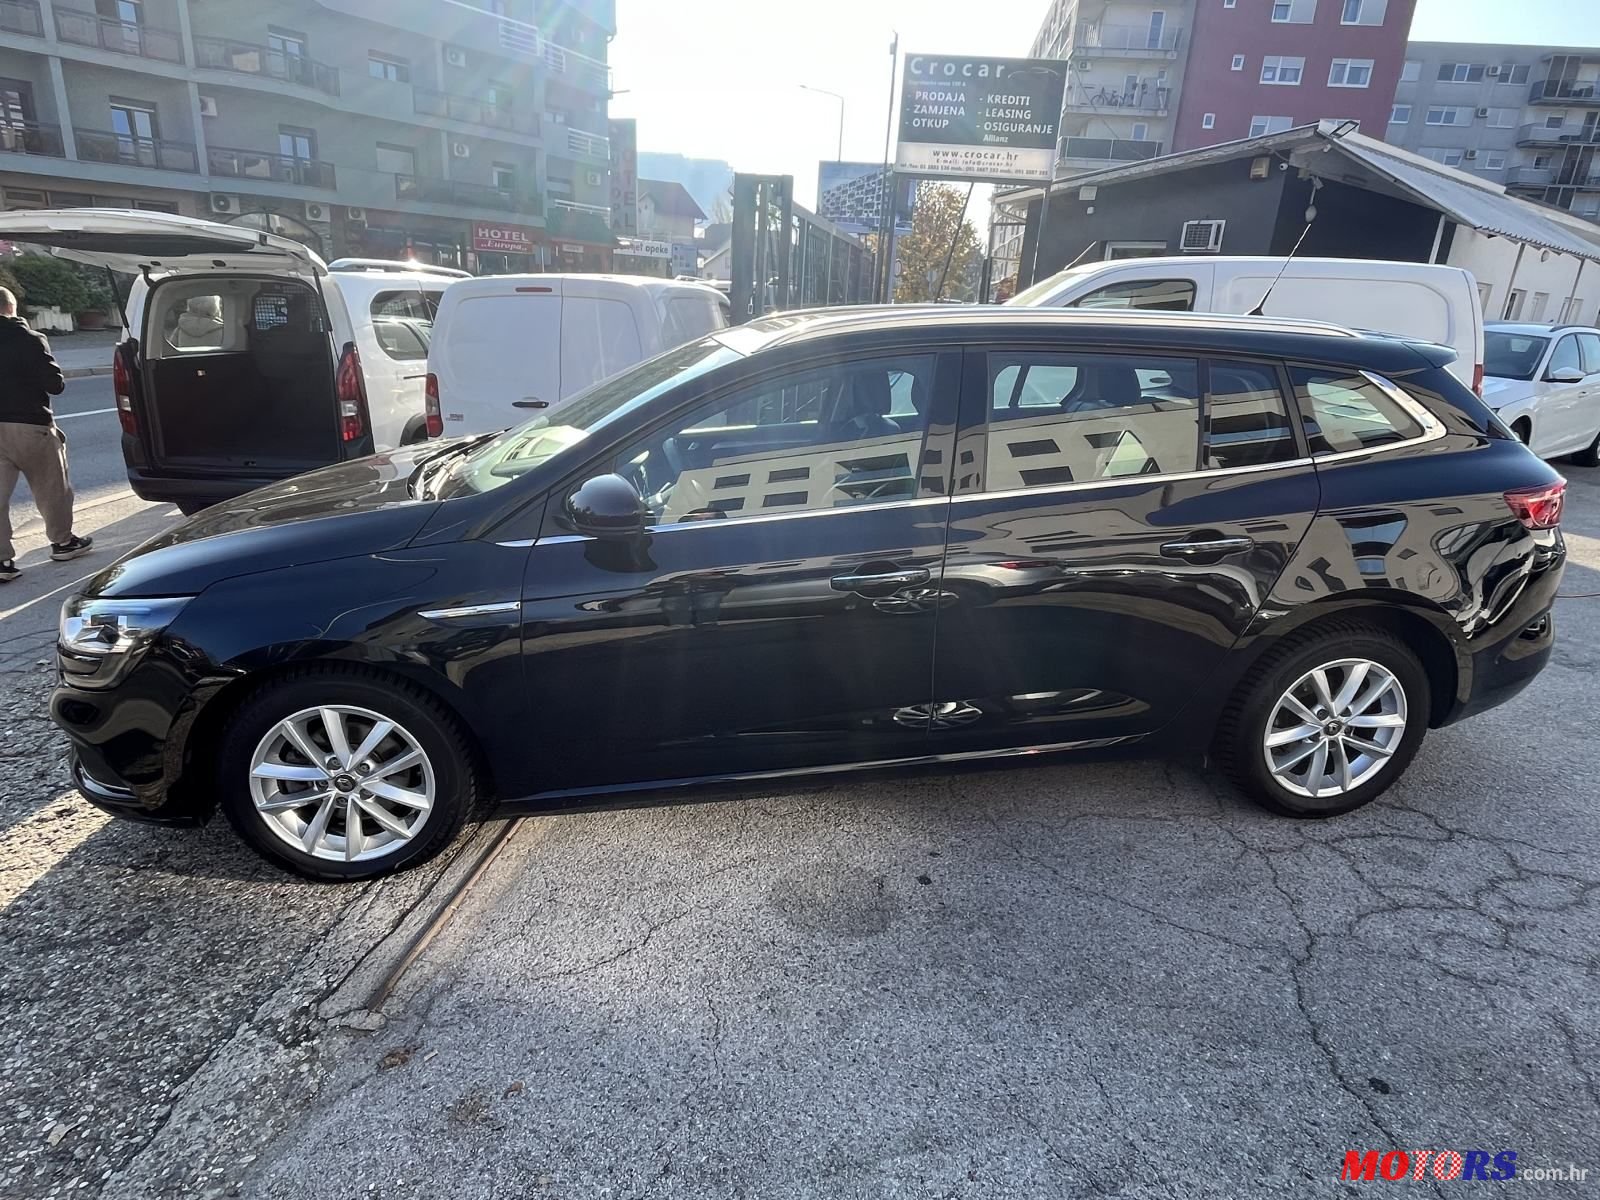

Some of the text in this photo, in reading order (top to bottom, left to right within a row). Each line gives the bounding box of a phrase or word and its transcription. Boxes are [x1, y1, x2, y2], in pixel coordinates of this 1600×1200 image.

[910, 57, 1005, 78] Crocar
[915, 91, 966, 102] PRODAJA
[987, 94, 1030, 106] KREDITI
[913, 104, 965, 116] ZAMJENA
[985, 108, 1031, 119] LEASING
[912, 118, 949, 128] OTKUP
[984, 122, 1053, 134] OSIGURANJE
[933, 150, 1018, 161] www.crocar.hr
[478, 227, 529, 242] HOTEL
